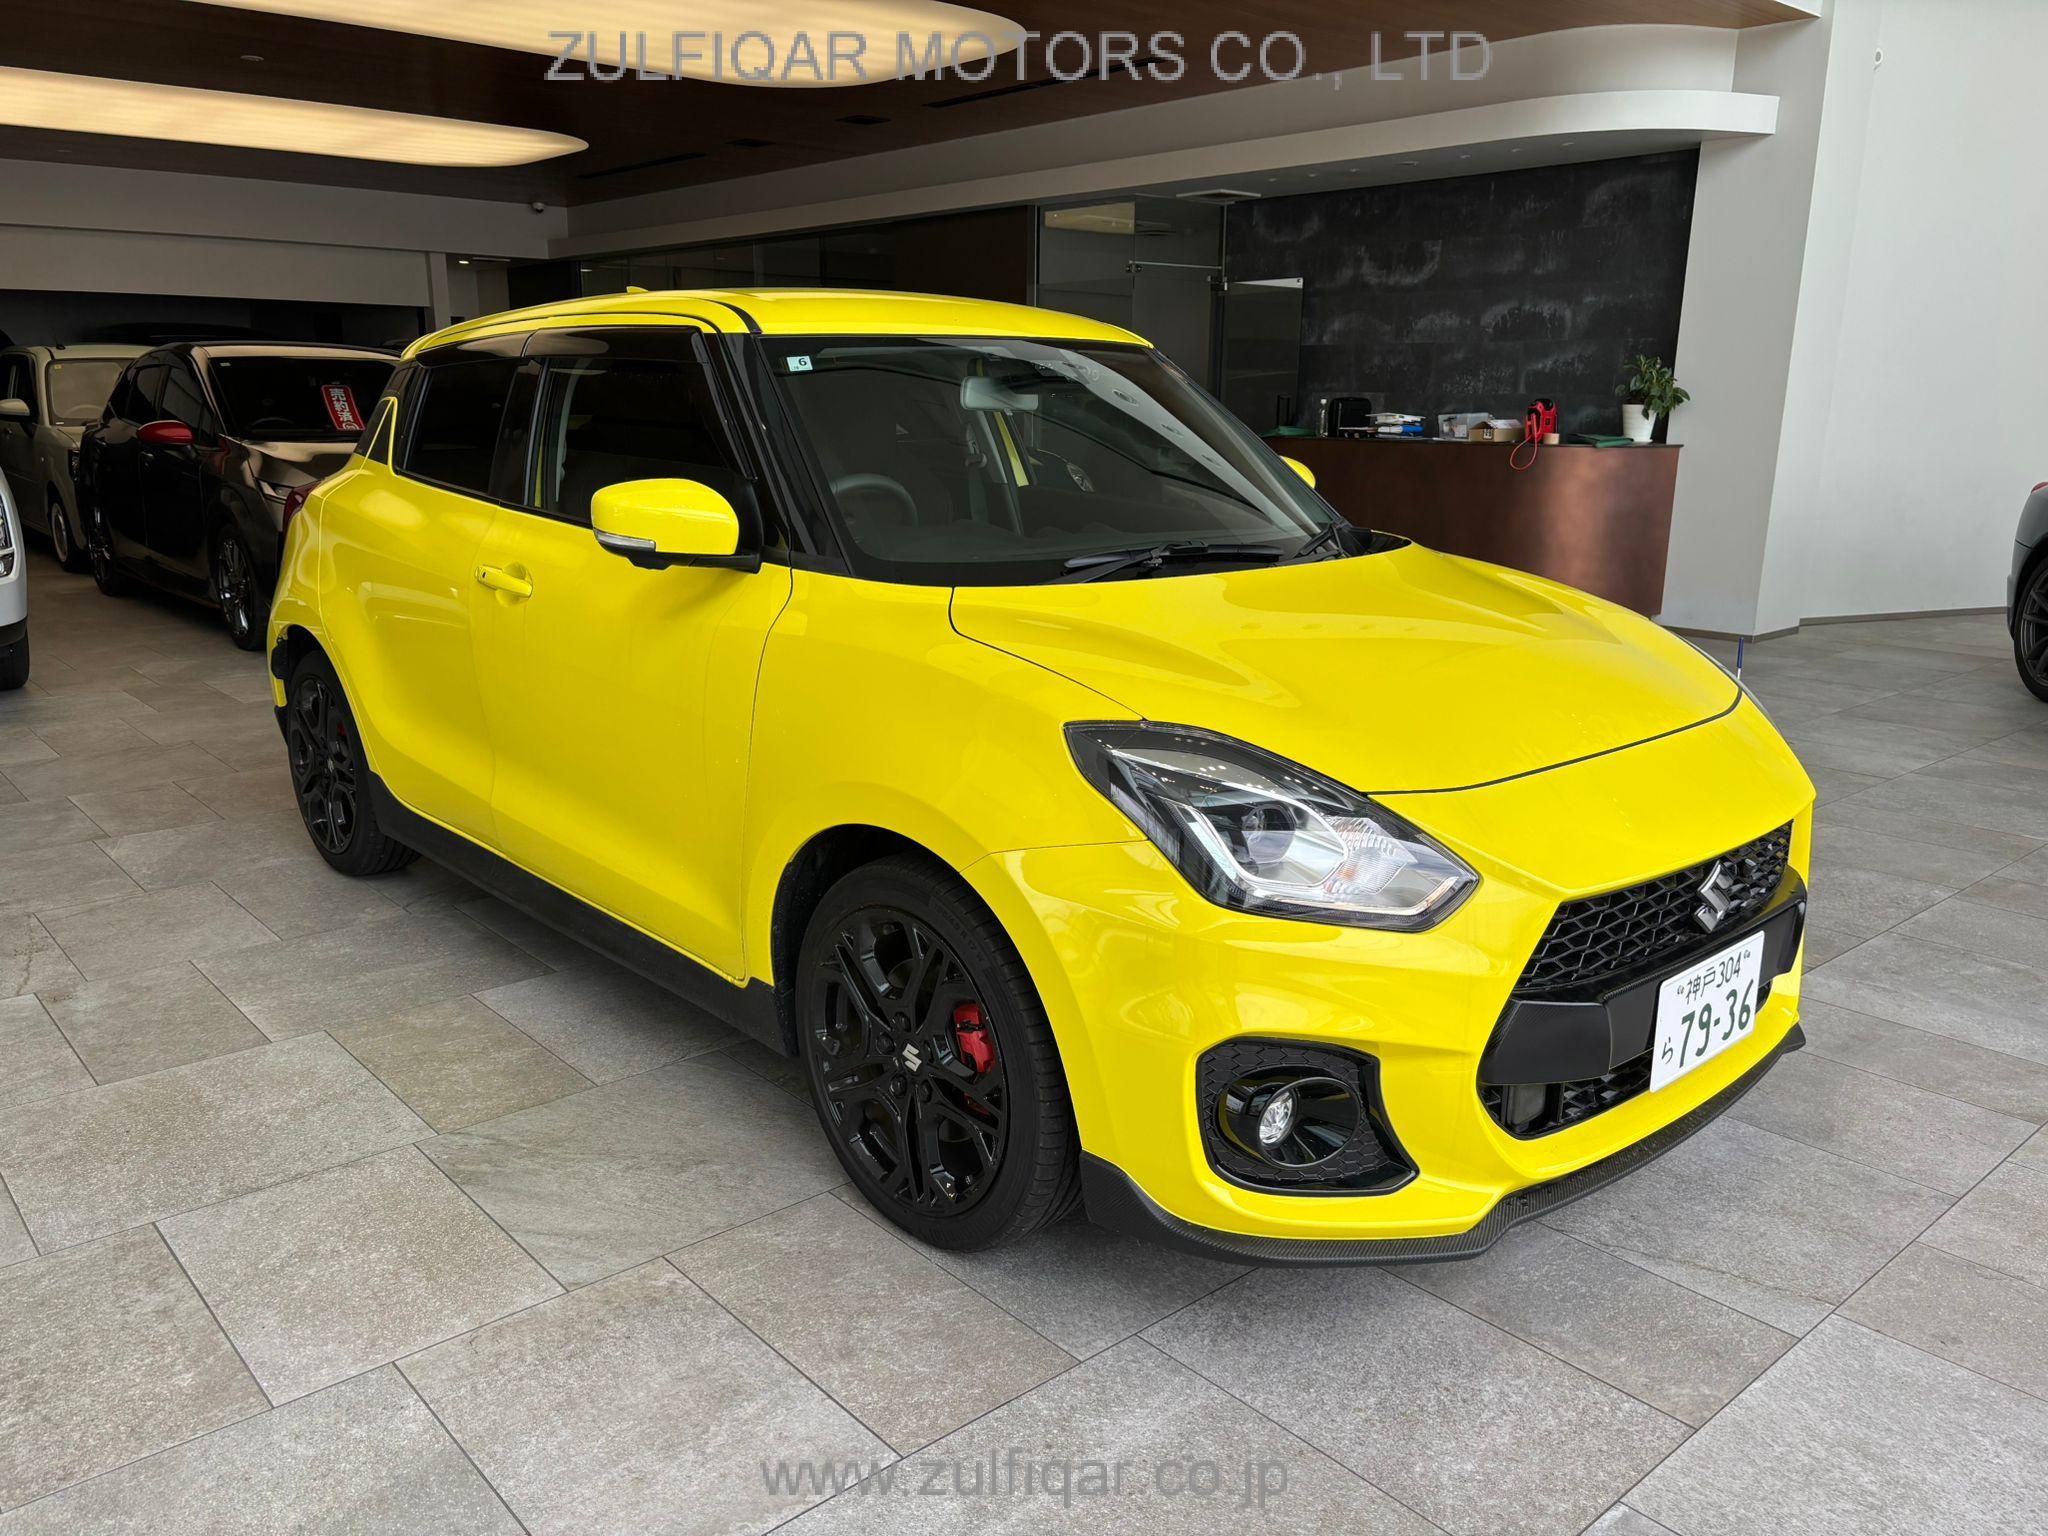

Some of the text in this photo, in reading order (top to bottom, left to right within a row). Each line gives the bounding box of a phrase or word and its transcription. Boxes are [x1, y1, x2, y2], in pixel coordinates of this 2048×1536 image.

[798, 357, 807, 366] 6
[1661, 979, 1754, 1068] ら 79-36
